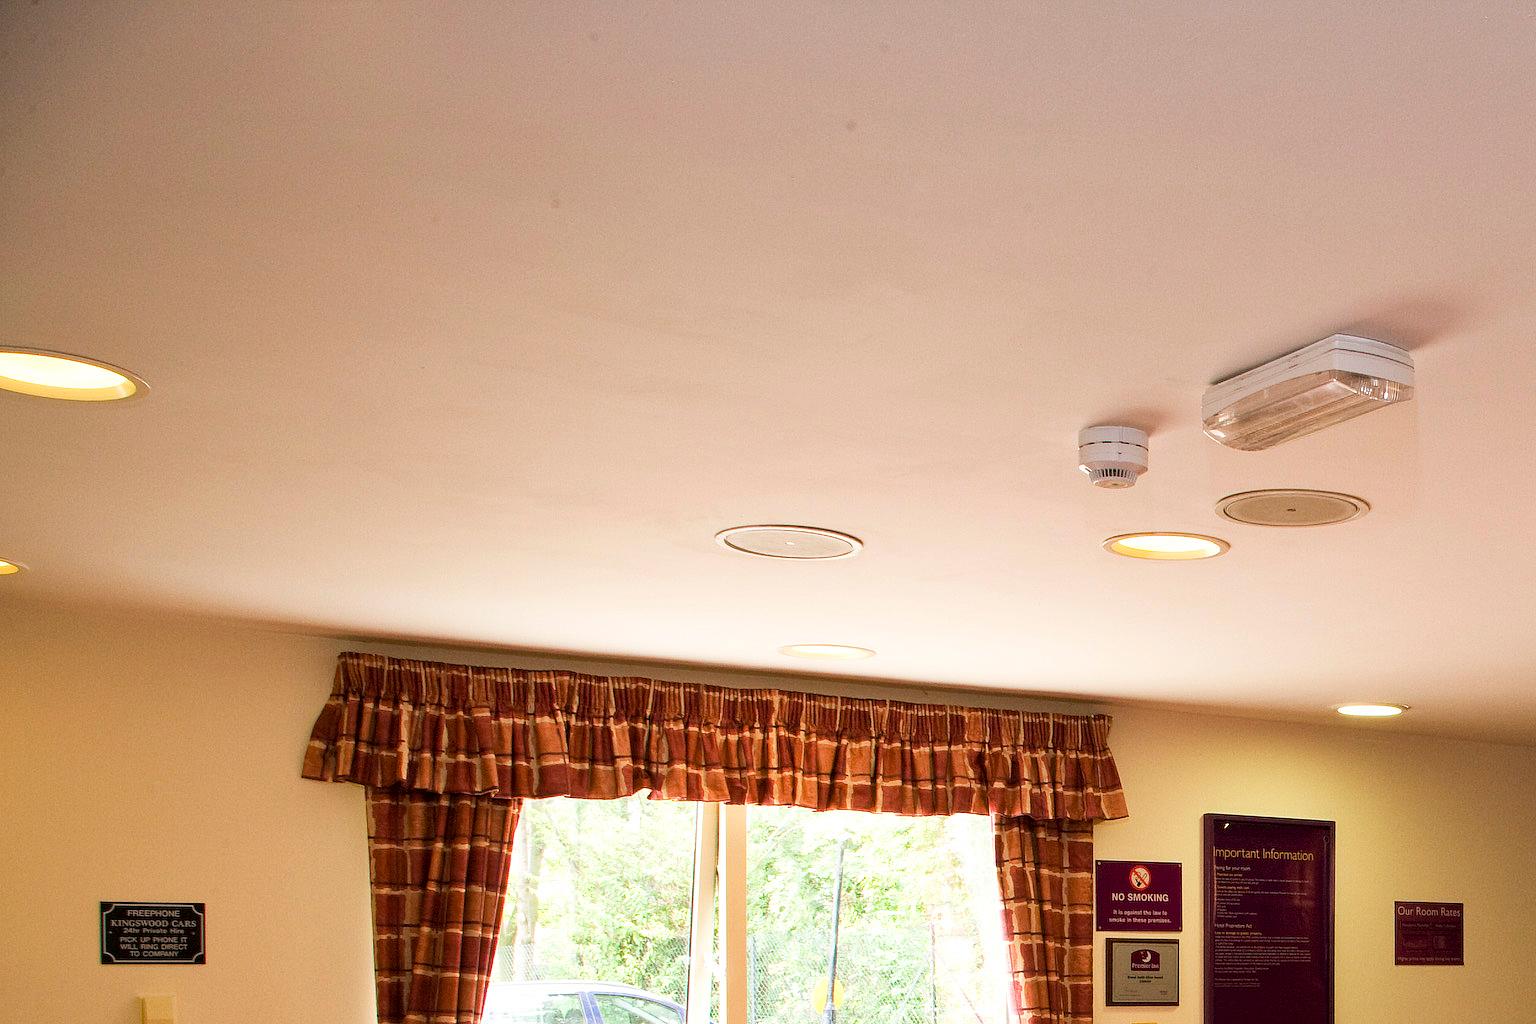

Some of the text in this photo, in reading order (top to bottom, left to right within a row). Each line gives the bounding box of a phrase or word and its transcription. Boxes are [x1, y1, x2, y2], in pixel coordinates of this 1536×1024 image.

[1213, 846, 1314, 861] Important Information
[1112, 893, 1168, 902] NO SMOKING
[1398, 906, 1460, 917] Our Room Rates
